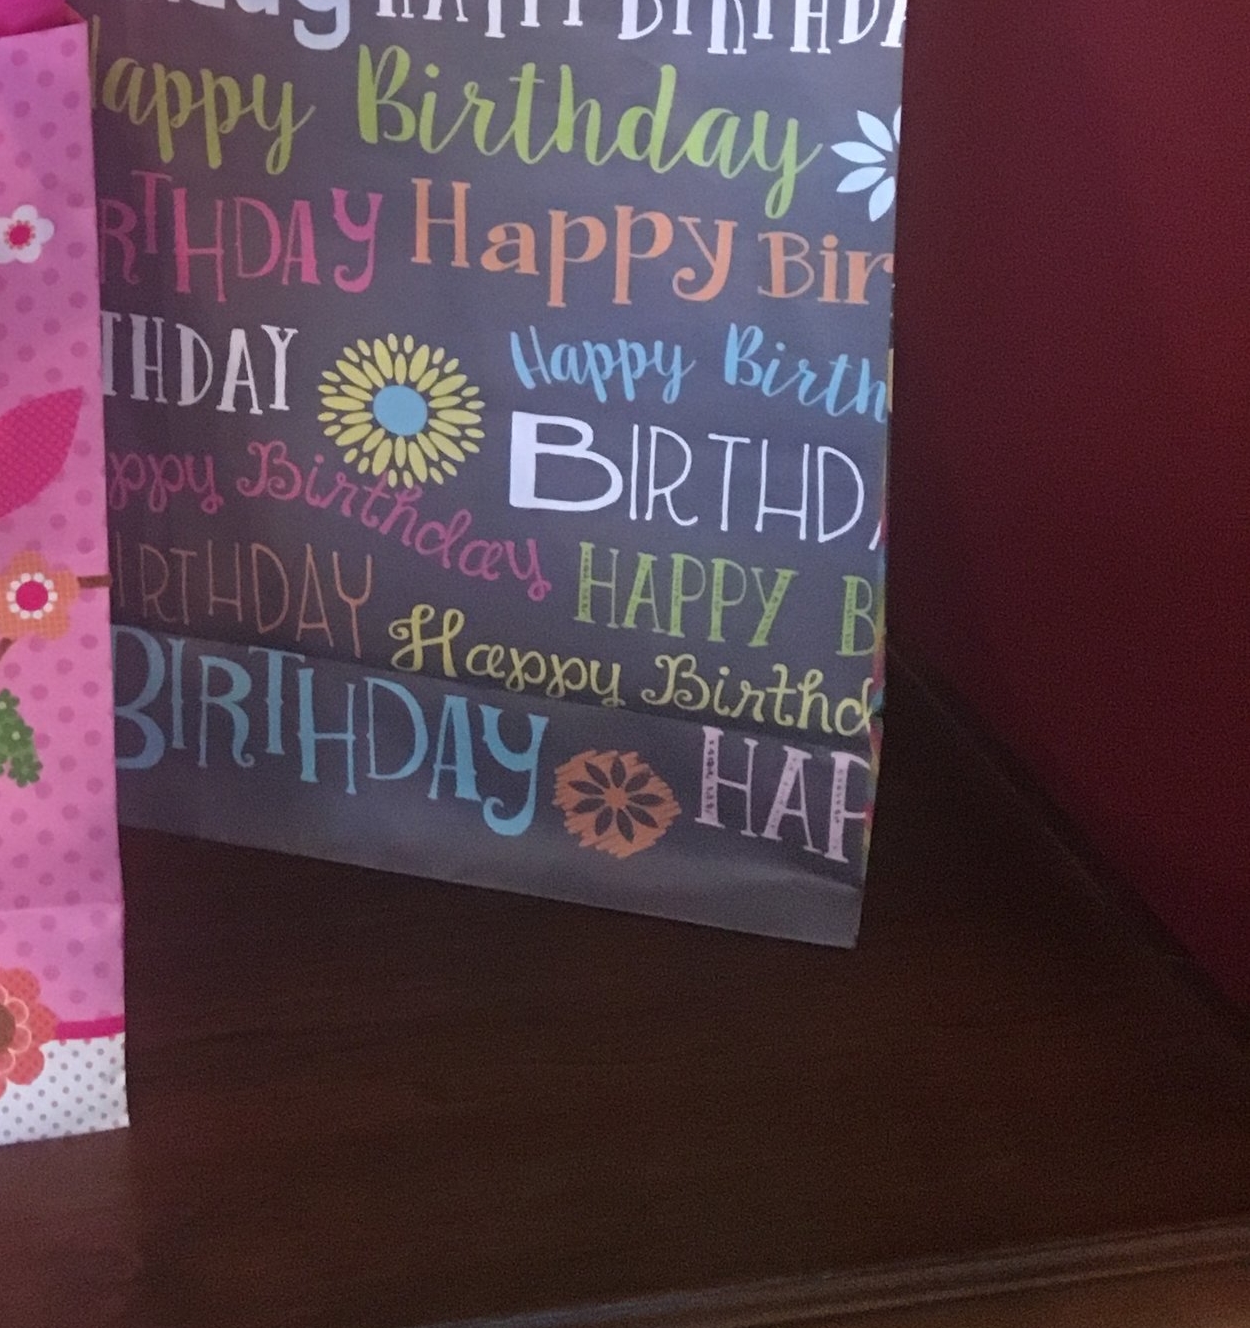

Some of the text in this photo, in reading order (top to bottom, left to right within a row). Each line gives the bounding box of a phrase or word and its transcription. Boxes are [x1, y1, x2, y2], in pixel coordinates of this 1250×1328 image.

[356, 43, 824, 220] Birthday
[410, 177, 894, 308] Happy Bir
[509, 322, 888, 424] Happy Birth
[236, 440, 552, 601] Birthday
[508, 410, 884, 551] BIRTHD
[387, 602, 626, 708] Happy
[574, 541, 800, 648] HAPPY
[110, 623, 550, 837] BIRTHDAY
